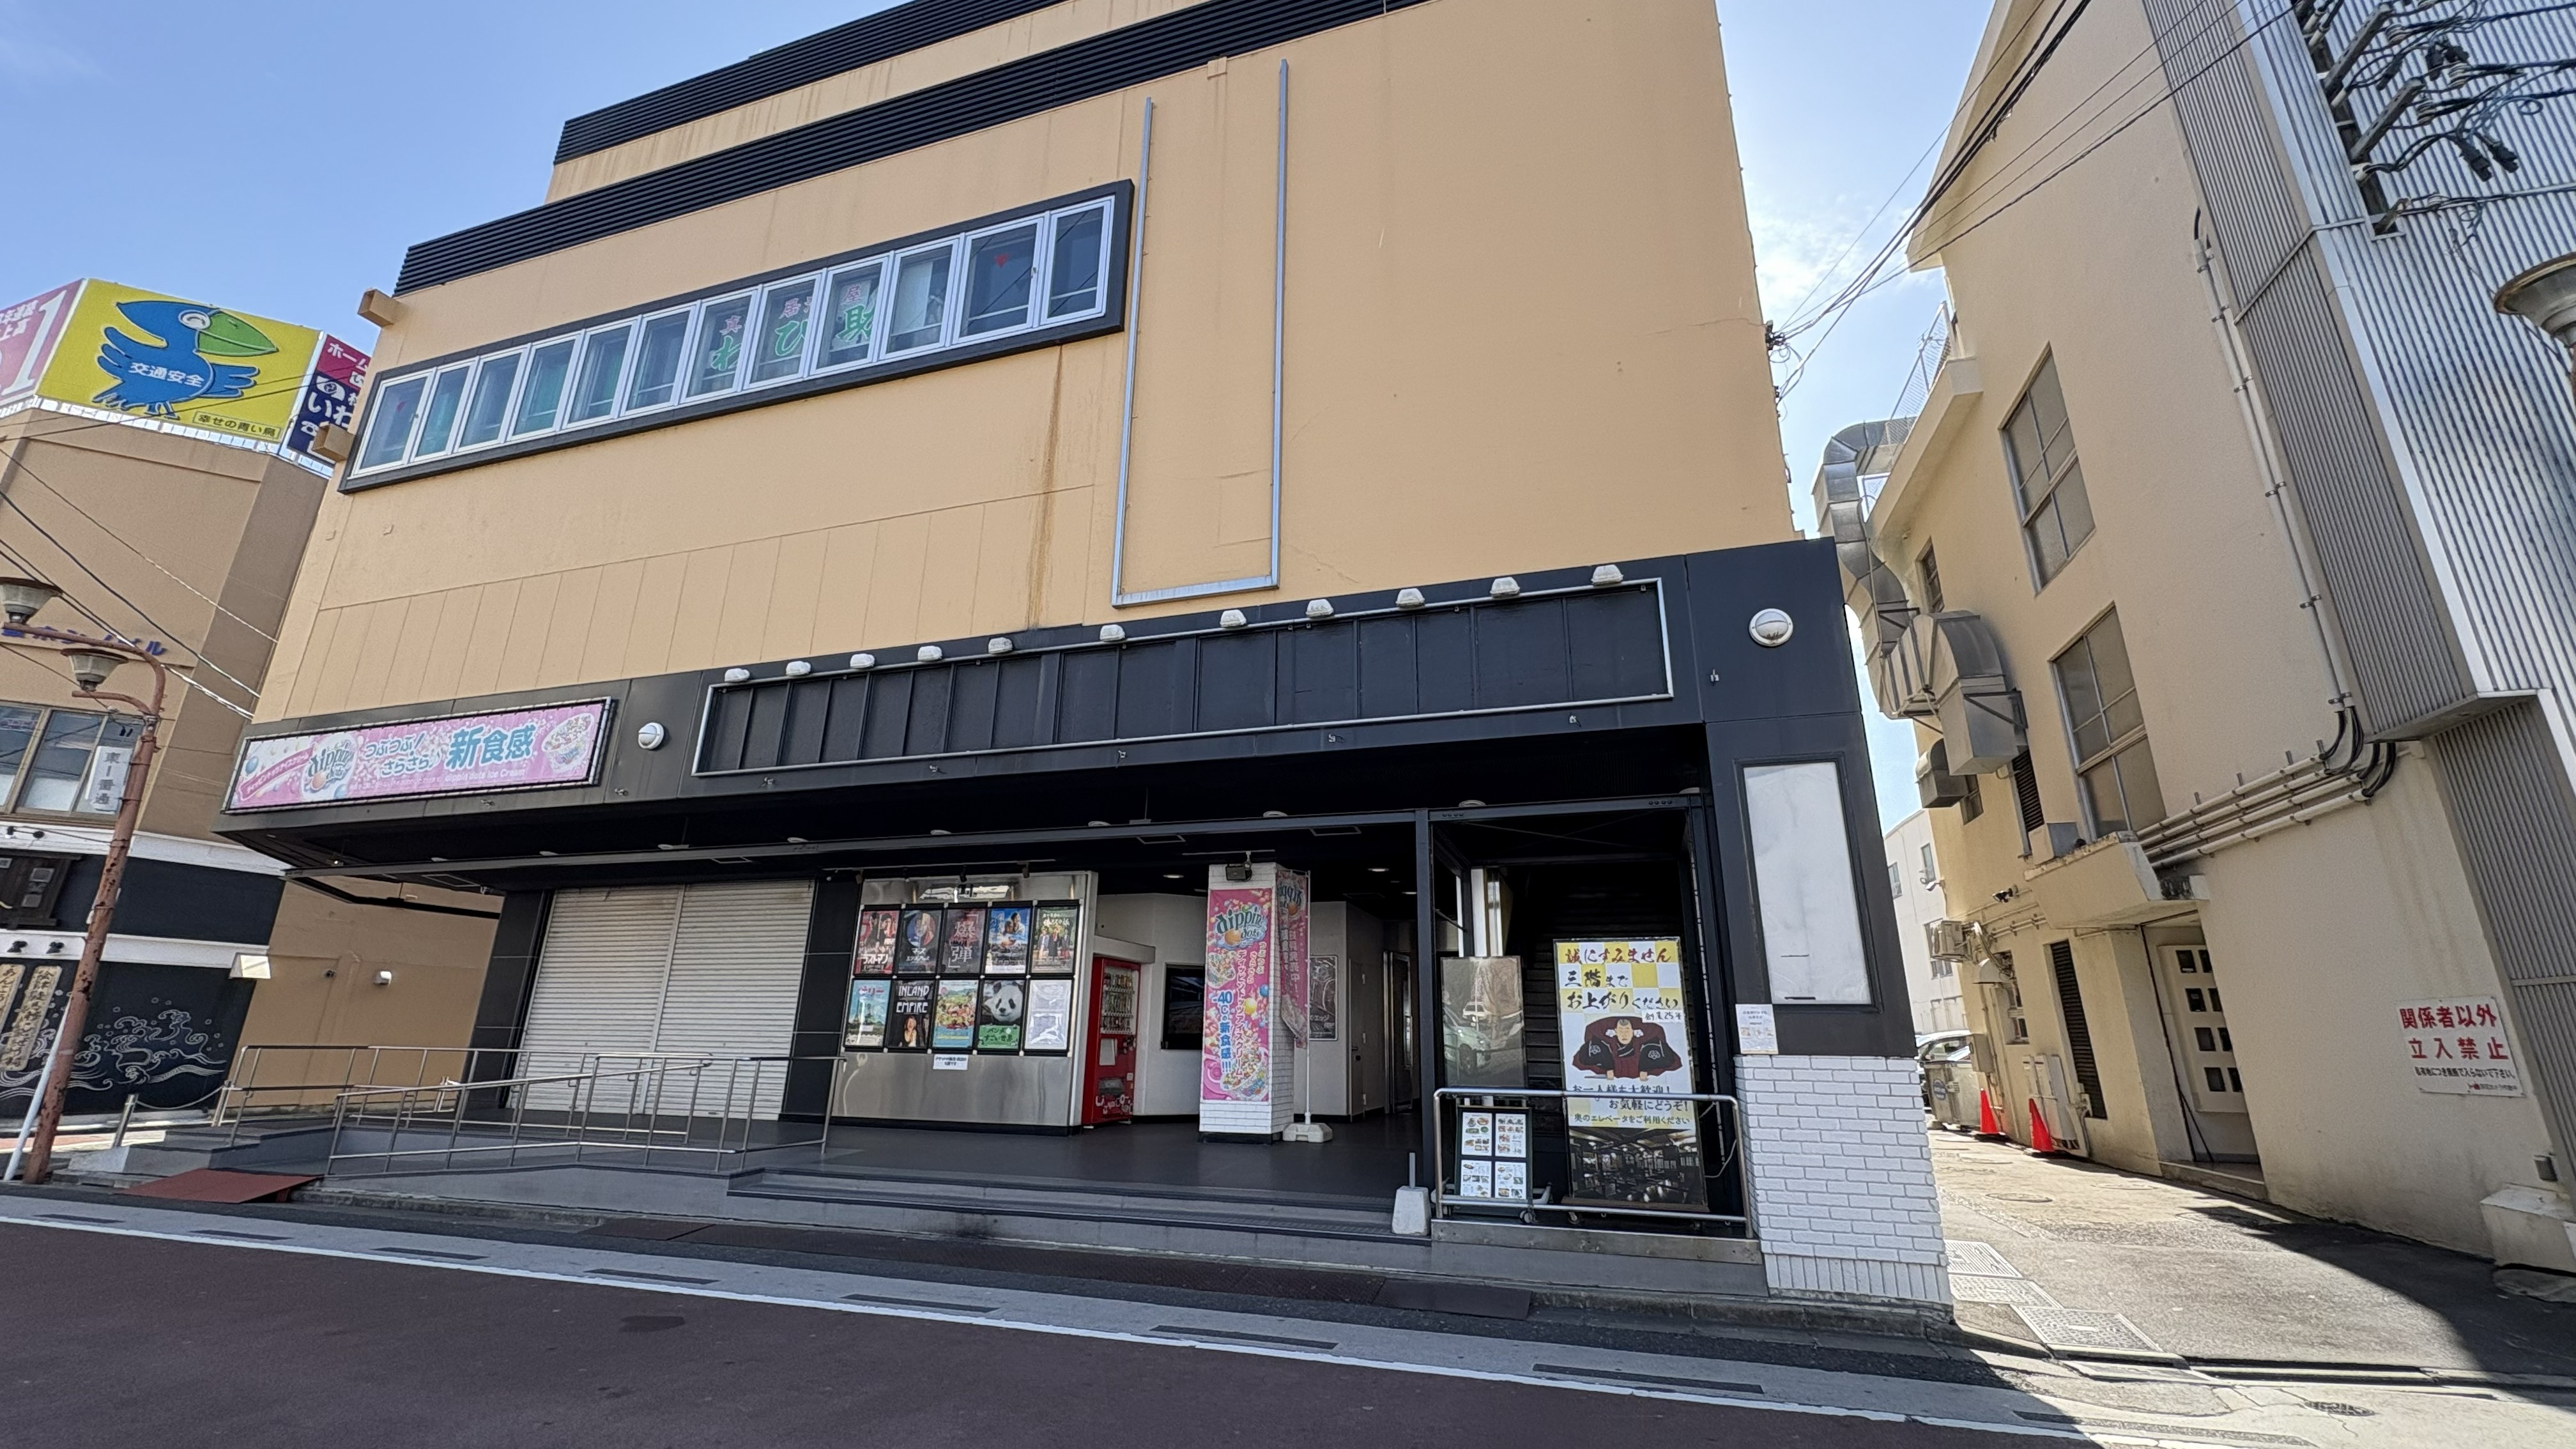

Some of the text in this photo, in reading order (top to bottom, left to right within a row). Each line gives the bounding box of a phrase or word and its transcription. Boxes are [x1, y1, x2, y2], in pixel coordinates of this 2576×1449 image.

[130, 362, 204, 387] 交通安全
[199, 415, 276, 436] 幸せの青い鳥
[446, 724, 537, 770] 新食感
[1241, 927, 1260, 939] dots
[1567, 947, 1671, 965] 誠にすみません
[1565, 968, 1629, 988] 三階まで
[898, 985, 930, 997] INLAND
[1567, 991, 1678, 1009] お上がりください
[896, 1001, 928, 1013] EMPIRE
[2399, 1003, 2497, 1029] 関係者以外
[2408, 1036, 2510, 1061] 立入禁止
